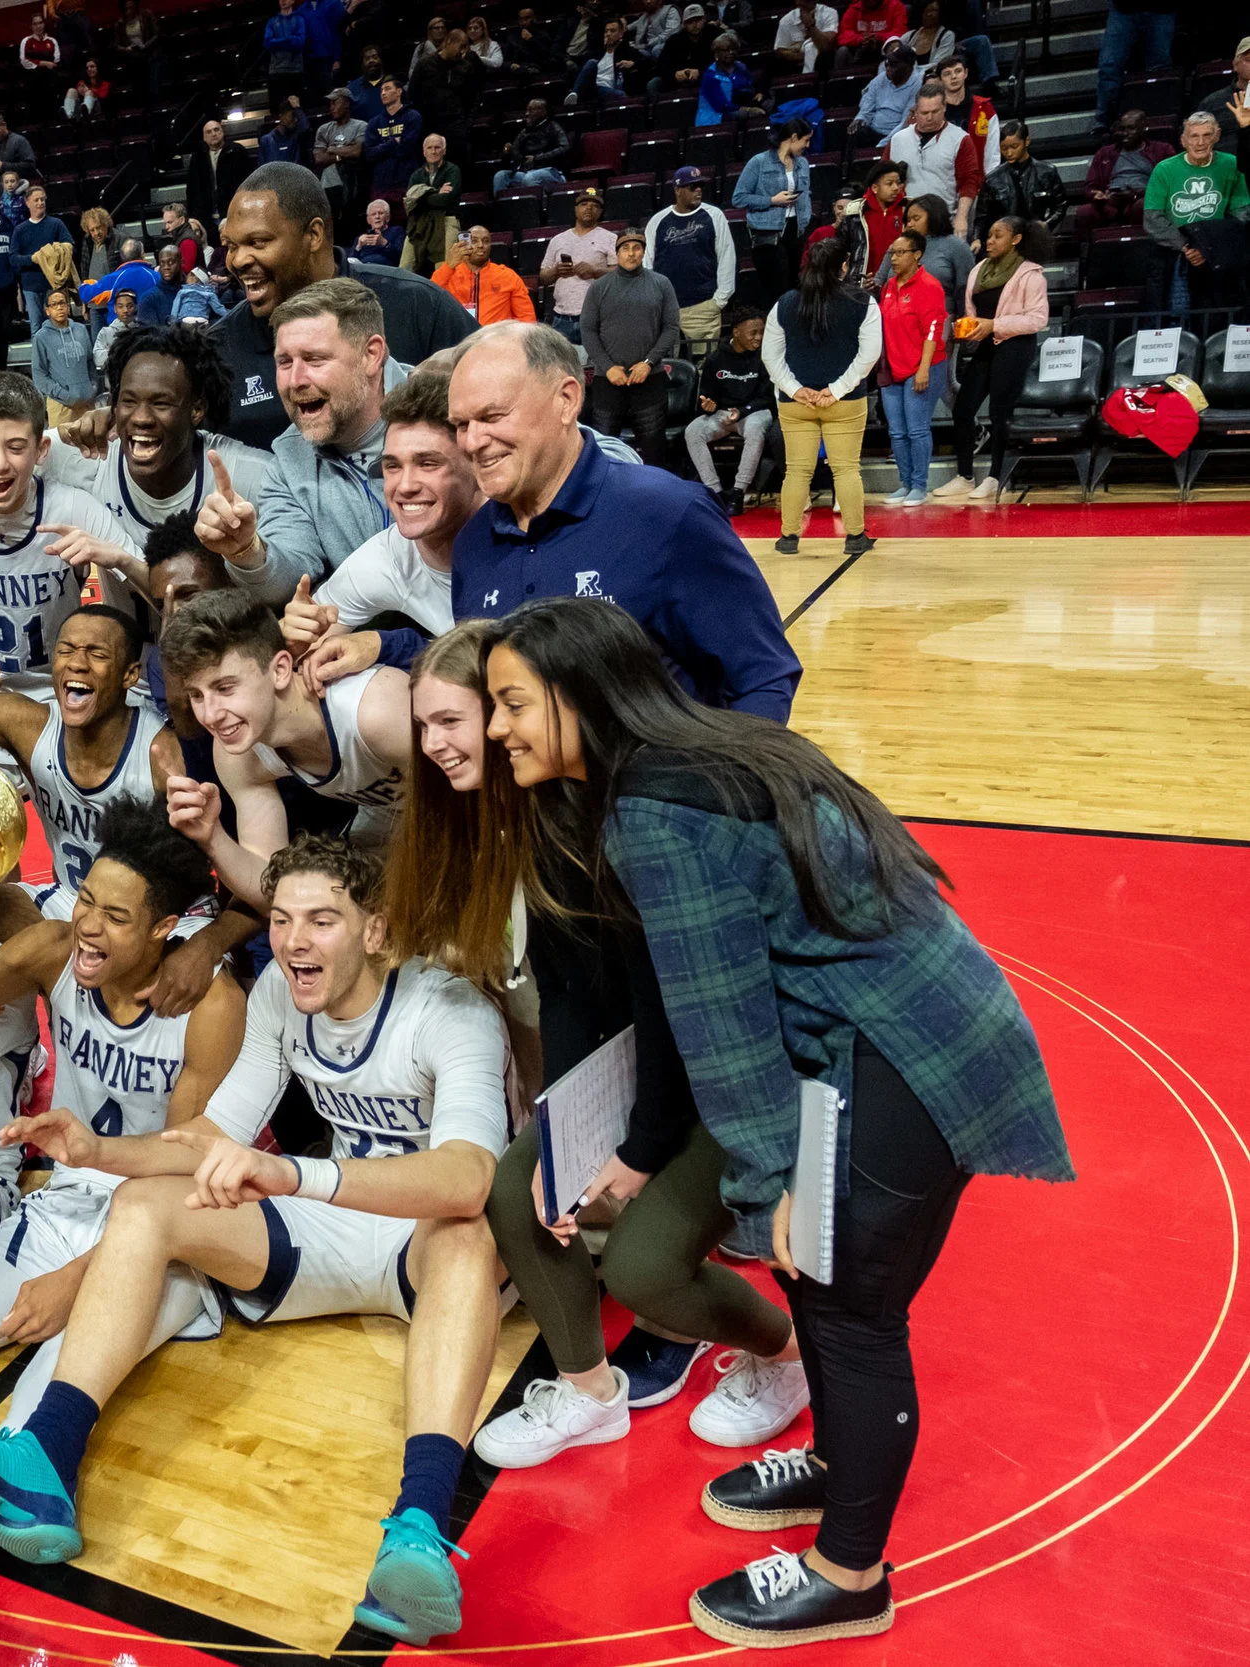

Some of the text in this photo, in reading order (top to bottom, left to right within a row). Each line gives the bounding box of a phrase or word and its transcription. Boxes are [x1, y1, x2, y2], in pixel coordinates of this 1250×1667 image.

[1190, 181, 1206, 194] N
[1046, 348, 1077, 357] RESERVED
[1141, 342, 1174, 350] RESERVED
[1048, 362, 1073, 370] SEATING
[245, 375, 265, 397] R
[240, 391, 274, 407] BASKETBALL
[575, 570, 603, 597] R
[59, 1015, 181, 1094] RANNEY
[313, 1081, 431, 1131] ANNEY
